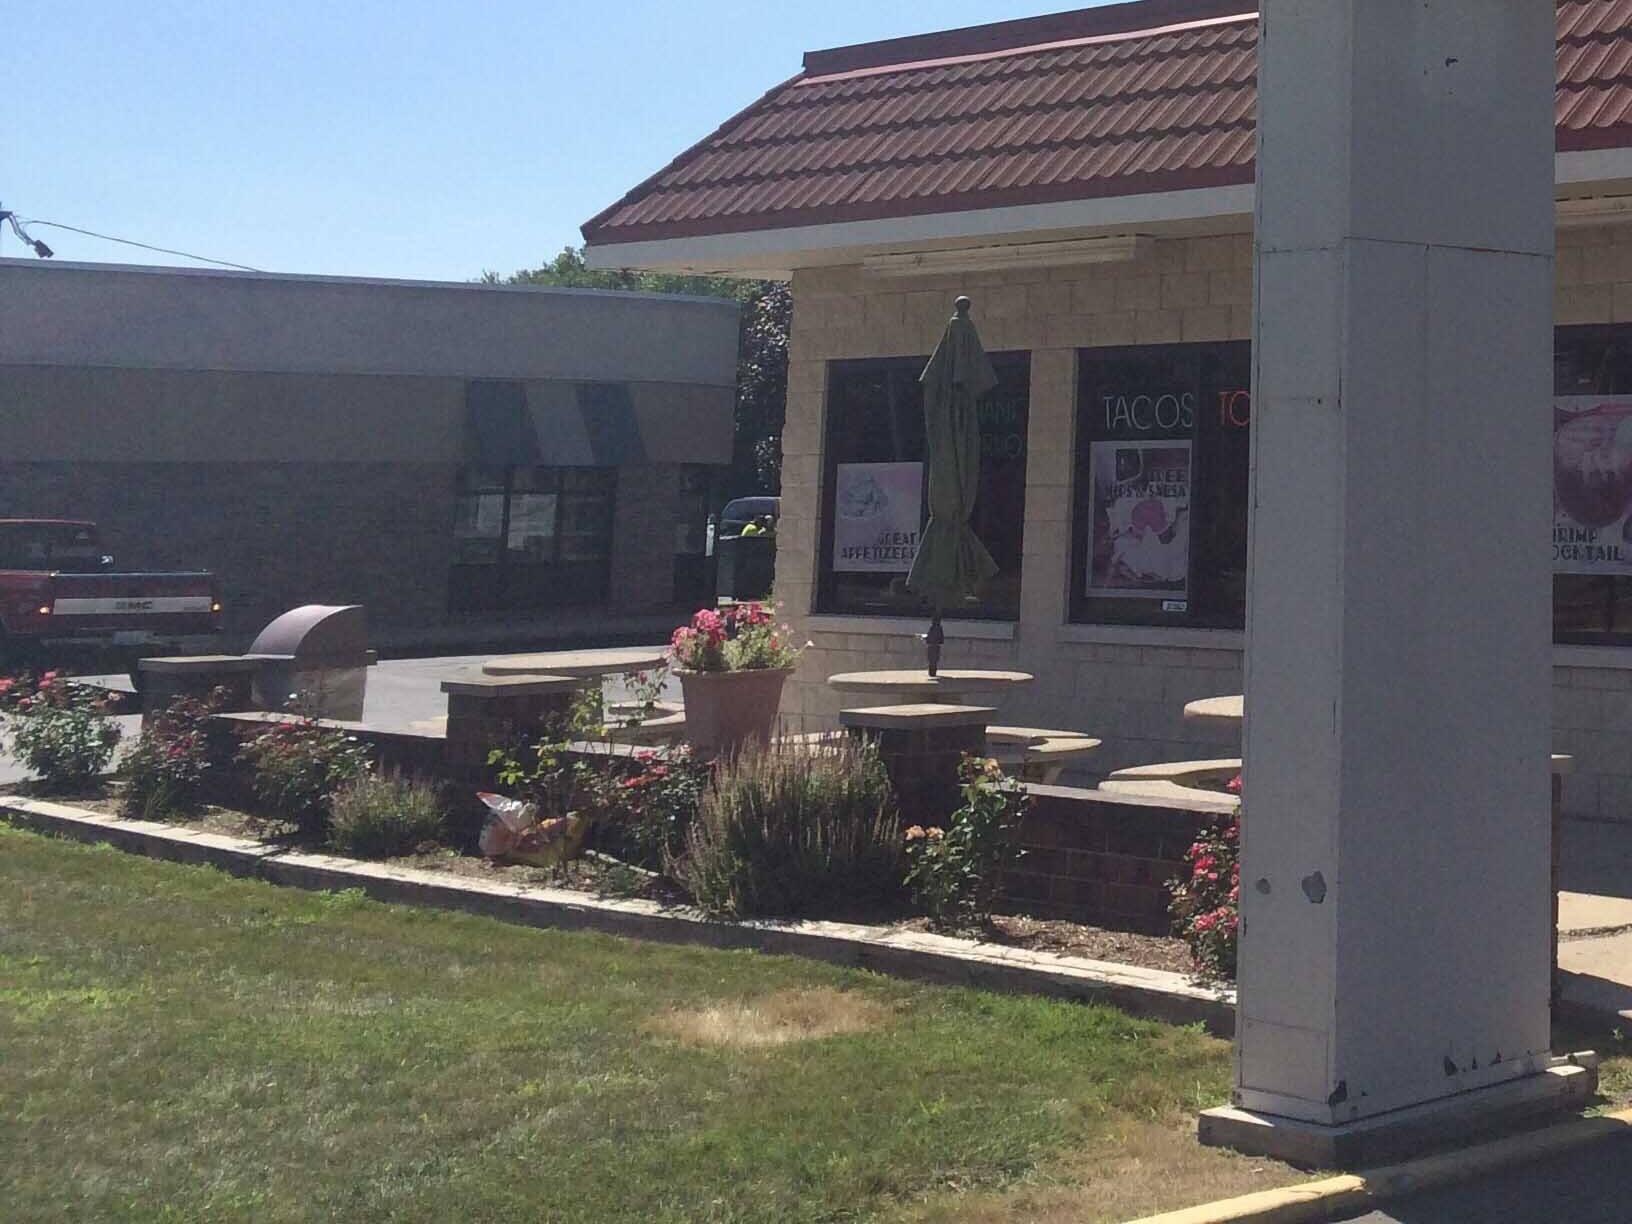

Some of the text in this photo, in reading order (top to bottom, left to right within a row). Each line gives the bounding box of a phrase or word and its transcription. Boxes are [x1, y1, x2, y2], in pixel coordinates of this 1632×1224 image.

[1104, 392, 1193, 430] TACOS
[1553, 526, 1598, 543] RIMP
[1553, 544, 1625, 561] OCKTAIL
